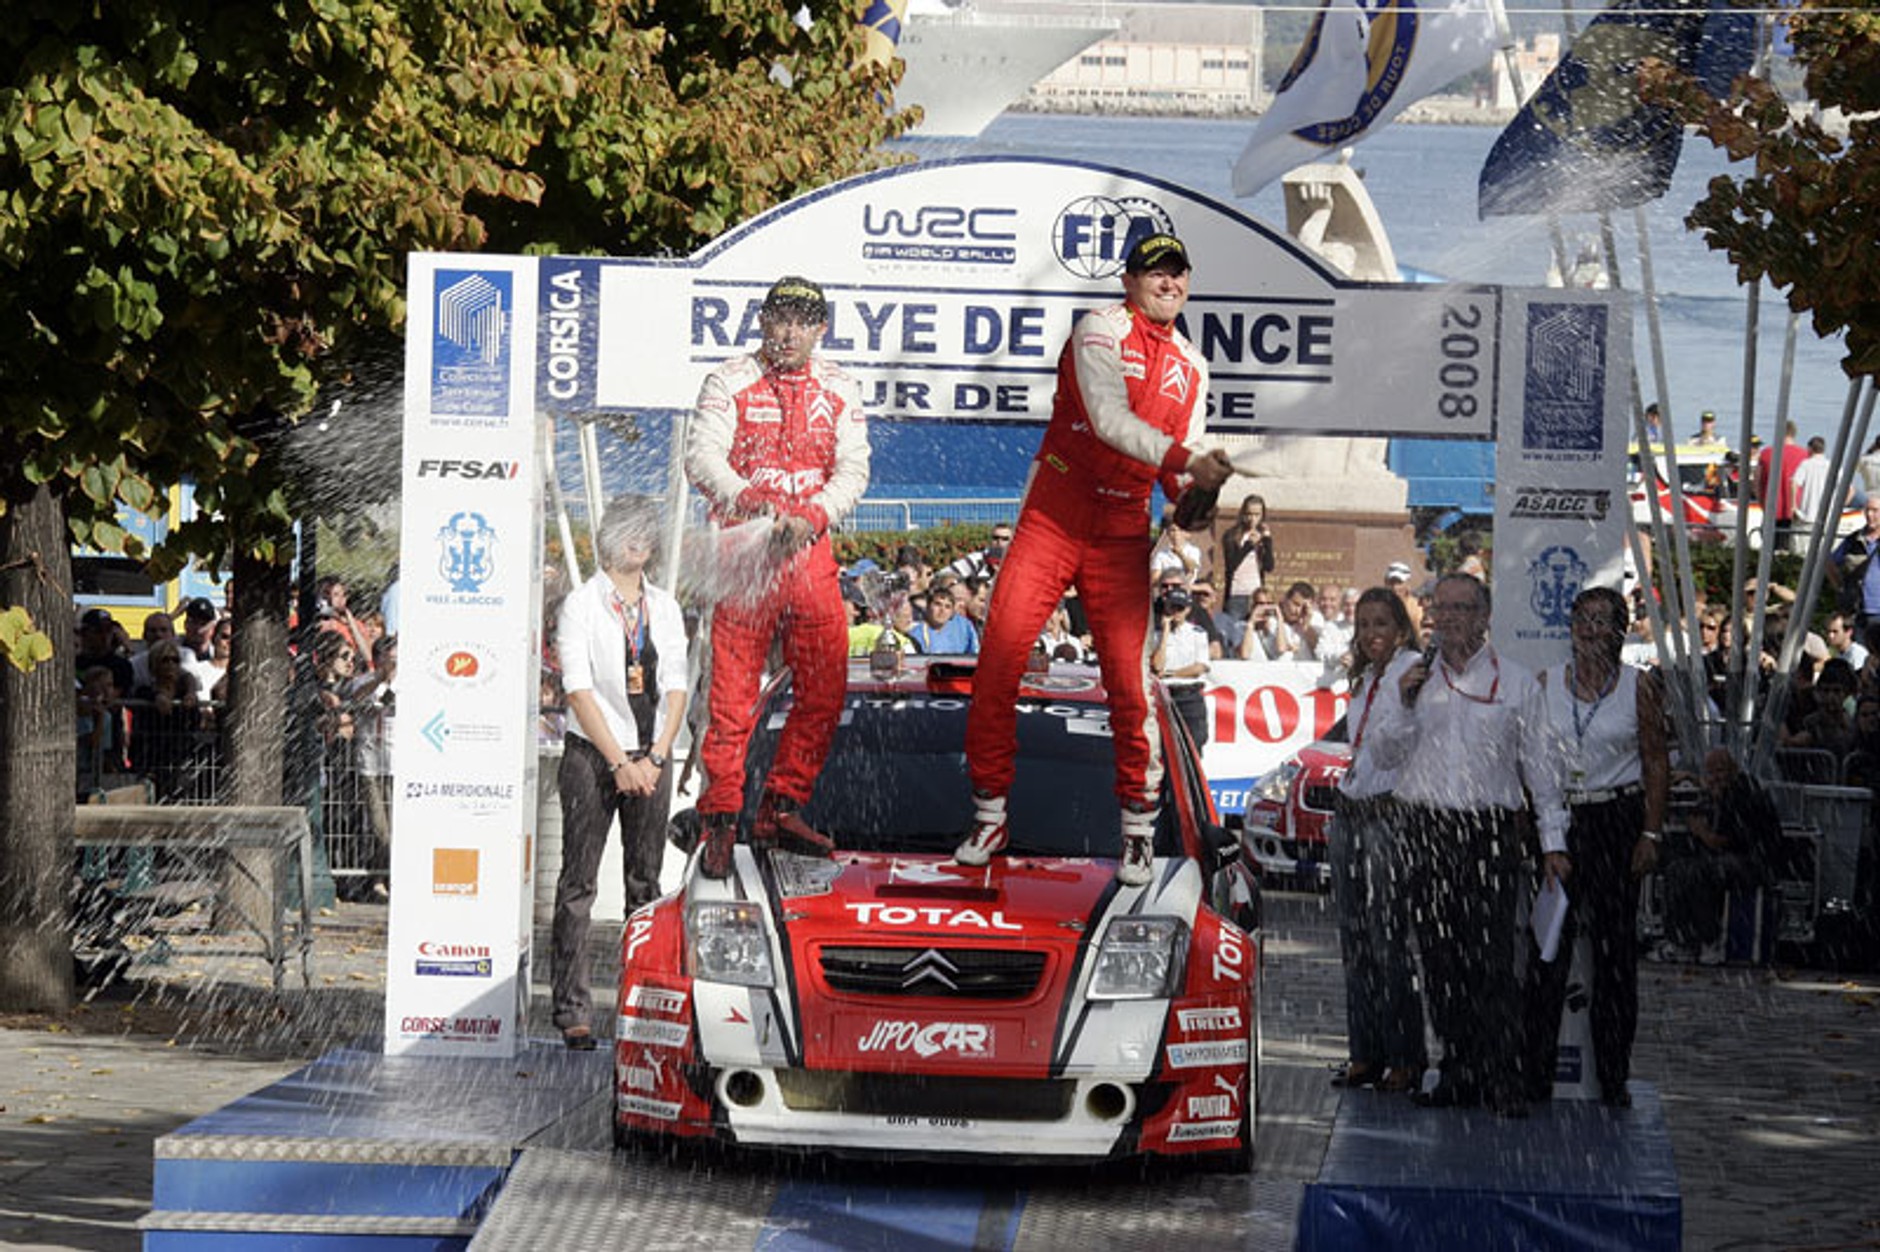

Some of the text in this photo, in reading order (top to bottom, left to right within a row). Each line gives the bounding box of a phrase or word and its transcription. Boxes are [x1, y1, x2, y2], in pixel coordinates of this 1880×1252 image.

[864, 203, 1018, 240] WRC
[958, 248, 1015, 261] RALLY
[547, 269, 582, 400] CORSICA
[689, 297, 938, 353] RALYE
[963, 305, 1046, 356] DE
[1438, 304, 1482, 418] 2008
[953, 383, 1029, 413] DE
[417, 460, 506, 479] FFSA
[1203, 684, 1352, 744] non
[846, 903, 1023, 930] TOTAL
[418, 942, 490, 958] Canon
[1188, 1095, 1231, 1119] PUMA
